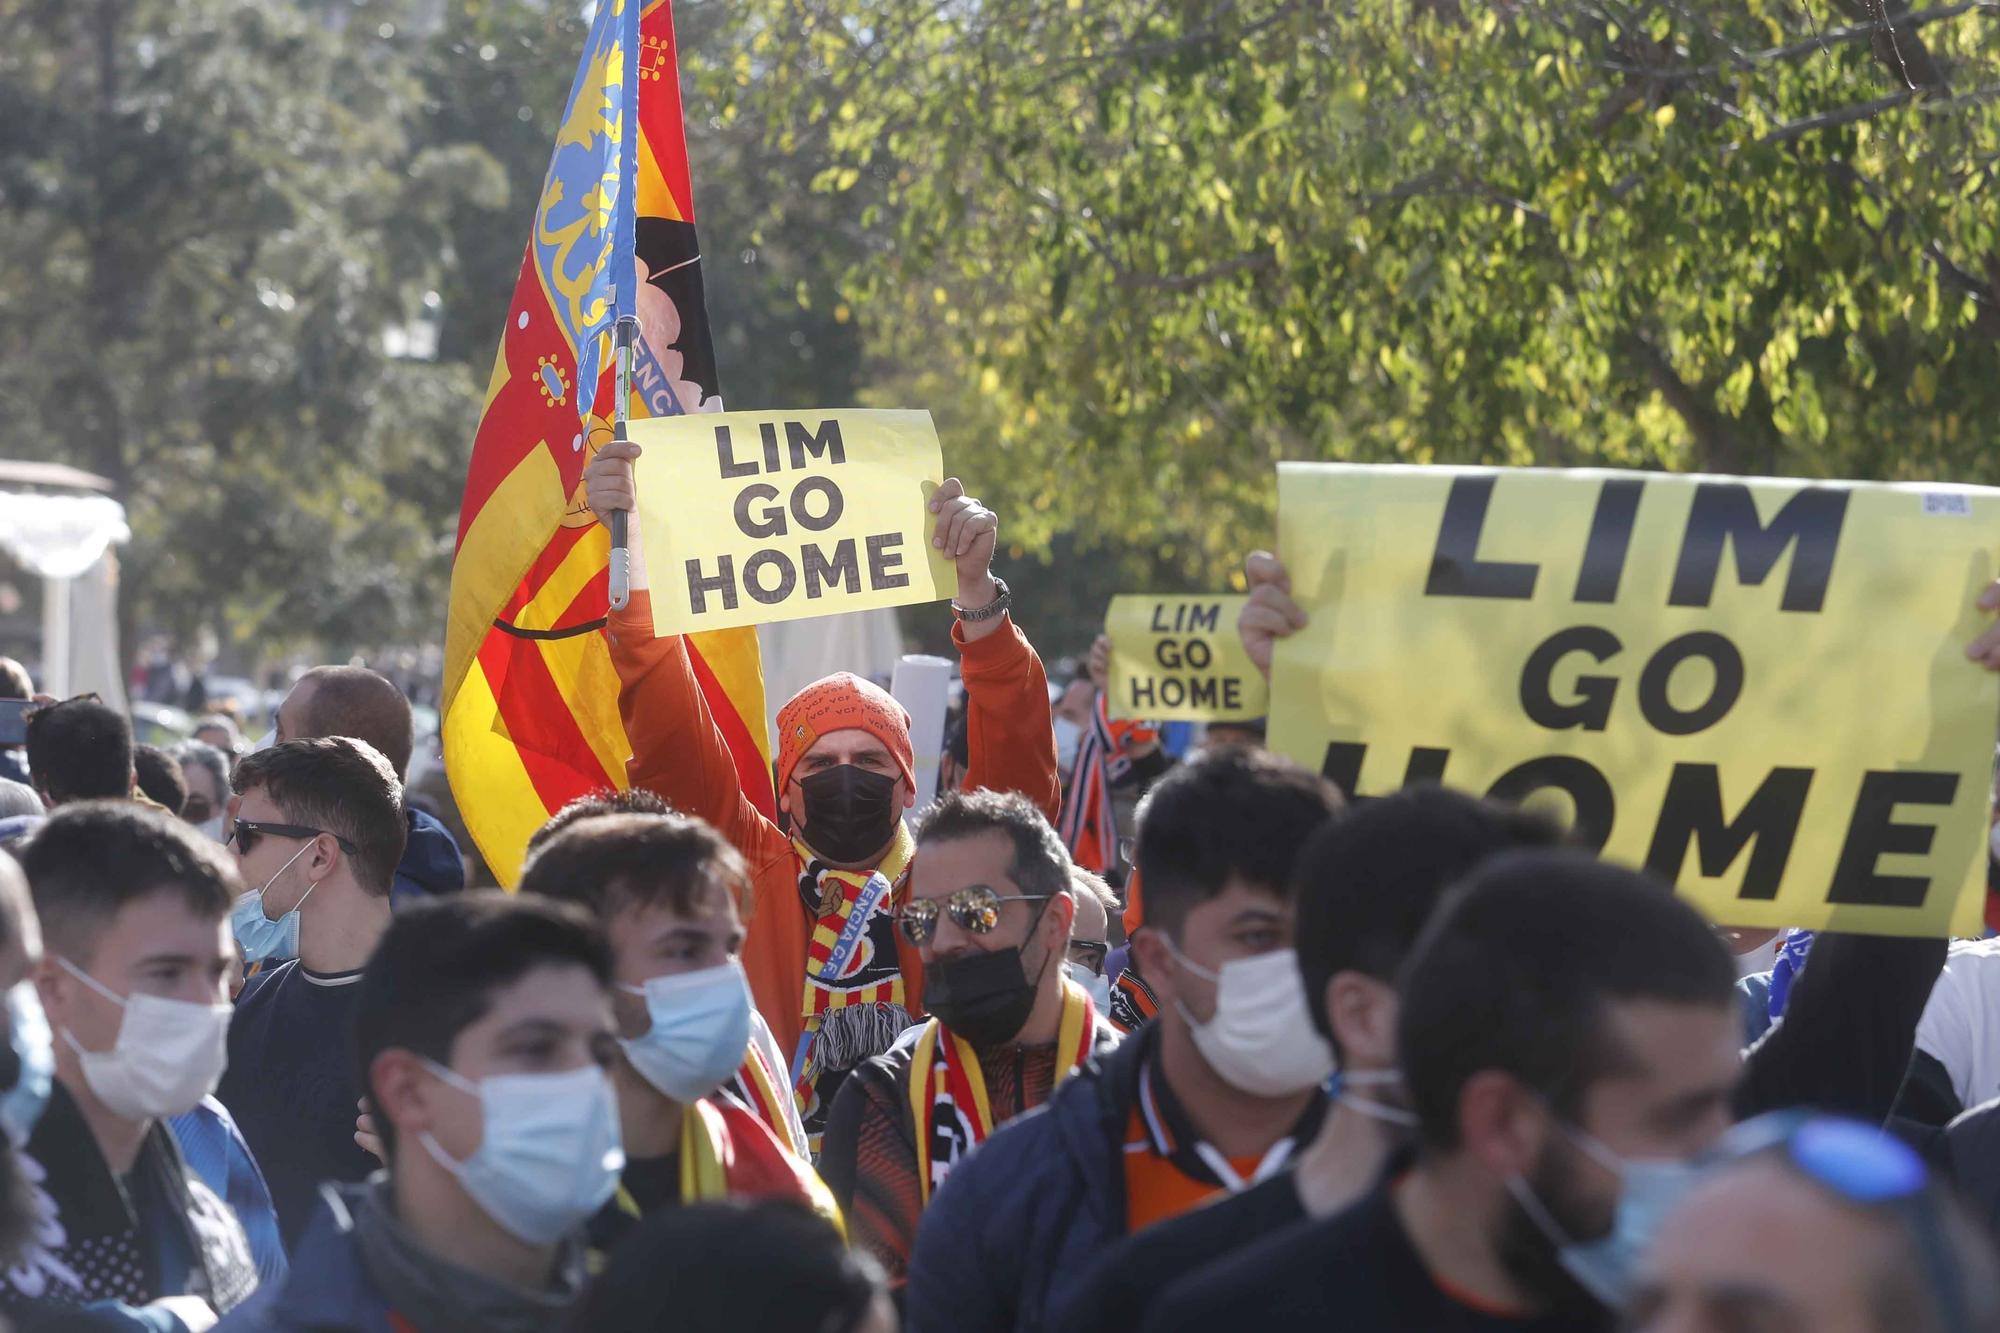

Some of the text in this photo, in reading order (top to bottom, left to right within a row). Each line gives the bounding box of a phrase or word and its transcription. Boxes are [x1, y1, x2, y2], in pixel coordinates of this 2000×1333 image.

[715, 419, 845, 479] LIM
[733, 475, 844, 539] GO
[686, 532, 910, 615] HOME
[1425, 478, 1849, 613] LIM
[1151, 603, 1221, 633] LIM
[1155, 638, 1212, 670] GO
[1519, 625, 1745, 736] GO
[1131, 676, 1242, 711] HOME
